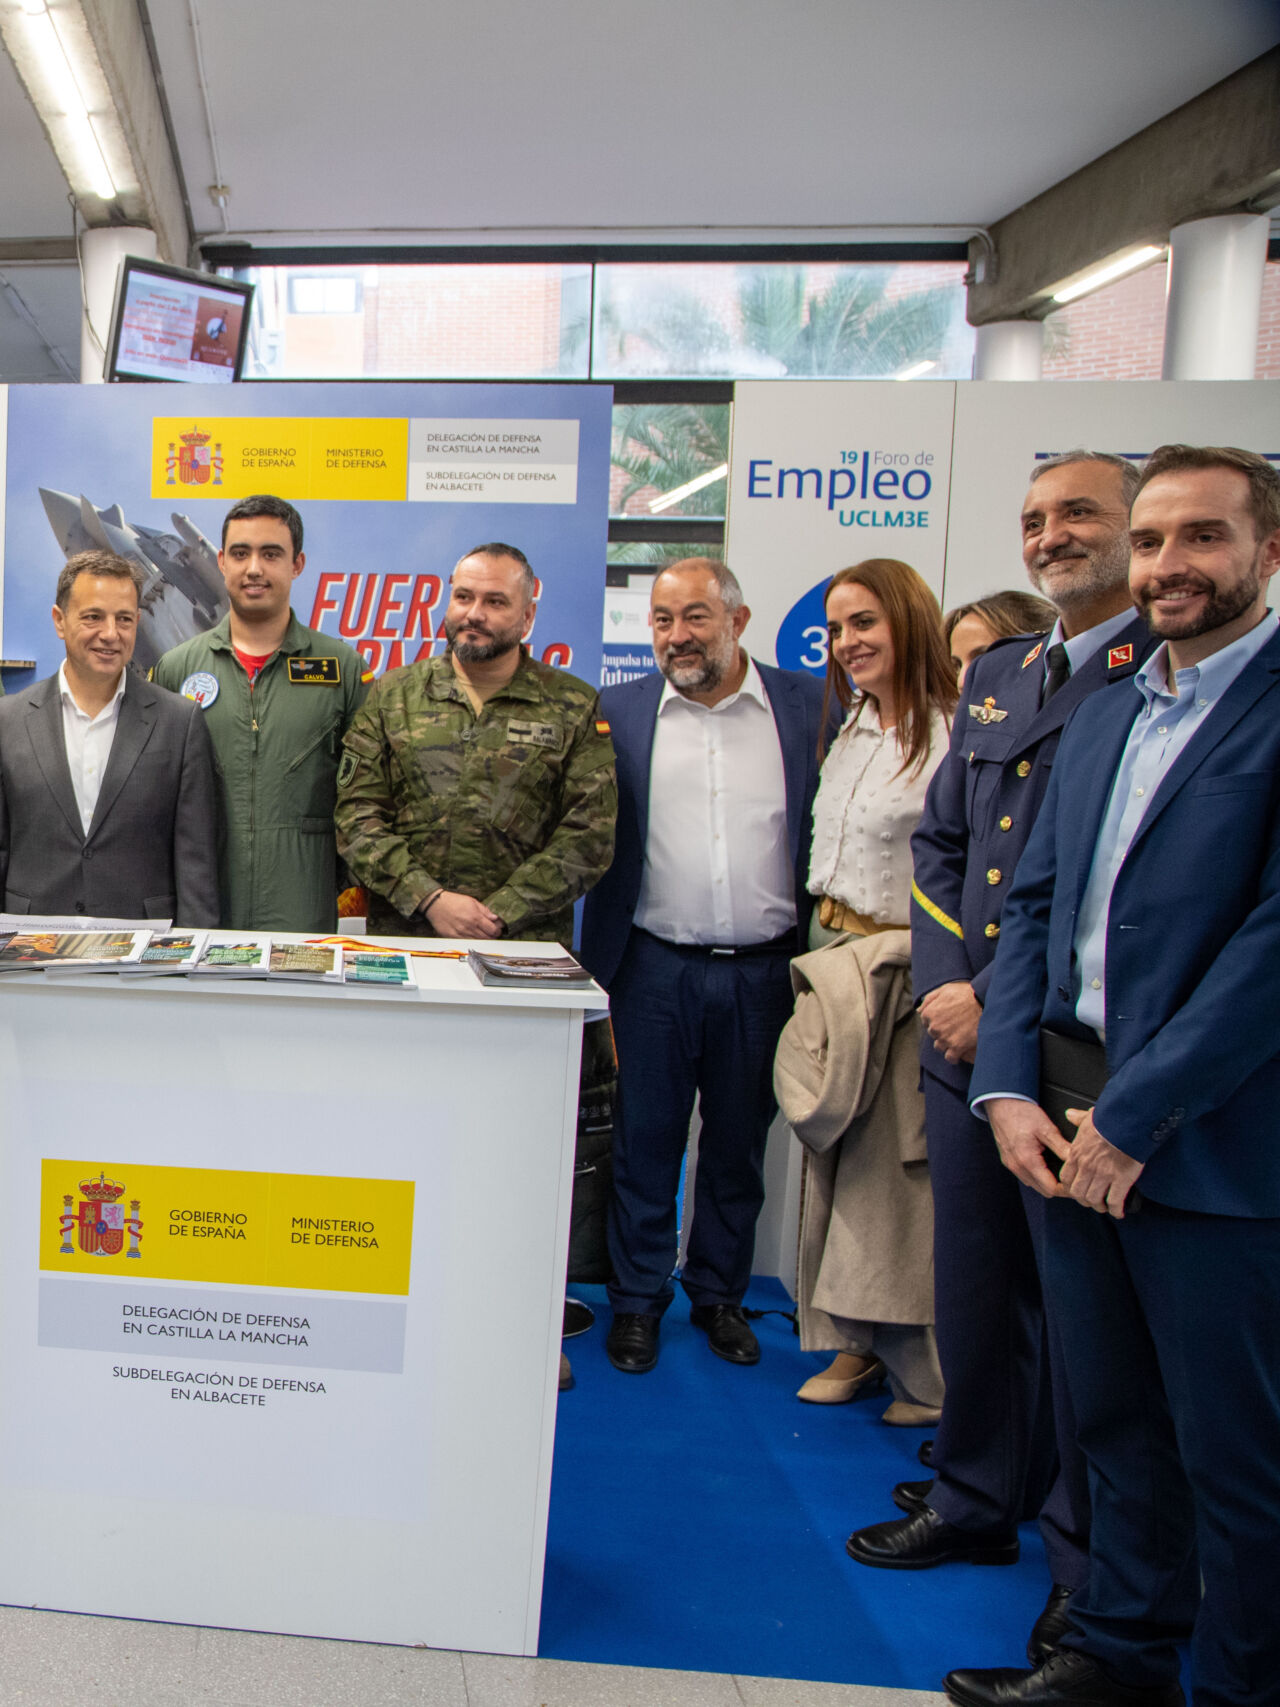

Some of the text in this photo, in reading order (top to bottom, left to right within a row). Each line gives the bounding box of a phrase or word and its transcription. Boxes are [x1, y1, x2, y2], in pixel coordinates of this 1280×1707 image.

[427, 432, 542, 443] DELEGACIÓN DE DEFENSA
[242, 448, 297, 457] GOBIERNO
[326, 449, 384, 458] MINISTERIO
[427, 445, 540, 454] EN CASTILLA LA MANCHA
[242, 457, 296, 468] DE ESPAÑA
[326, 460, 387, 469] DE DEFENSA
[840, 451, 858, 465] 19
[874, 451, 935, 466] Foro de
[426, 470, 557, 481] SUBDELEGACIÓN DE DEFENSA
[748, 451, 932, 511] Empleo
[426, 483, 485, 491] EN ALBACETE
[839, 510, 929, 528] UCLM3E
[603, 654, 654, 668] Impulsa tu
[304, 673, 325, 681] CALVO
[169, 1209, 248, 1225] GOBIERNO
[169, 1224, 247, 1241] DE ESPAÑA
[291, 1217, 375, 1234] MINISTERIO
[291, 1232, 380, 1249] DE DEFENSA
[122, 1304, 311, 1330] DELEGACIÓN DE DEFENSA
[122, 1322, 309, 1347] EN CASTILLA LA MANCHA
[112, 1366, 327, 1394] SUBDELEGACIÓN DE DEFENSA
[171, 1388, 266, 1407] EN ALBACETE
